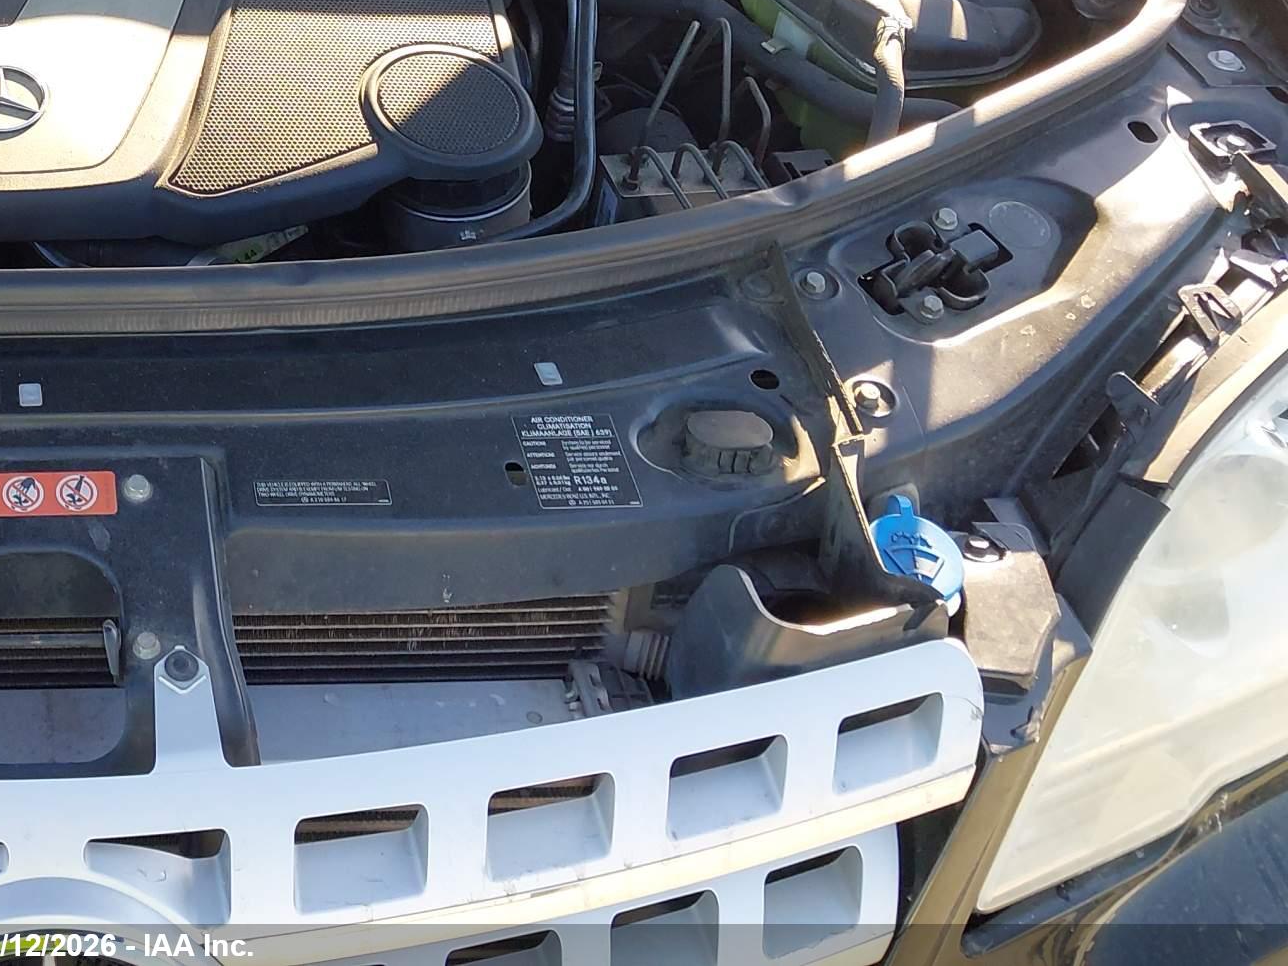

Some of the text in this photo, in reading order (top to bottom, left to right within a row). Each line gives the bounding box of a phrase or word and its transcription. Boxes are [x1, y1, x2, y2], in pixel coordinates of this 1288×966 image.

[544, 415, 593, 423] CONDITIONER
[537, 423, 592, 431] CLIMATISATION
[573, 475, 608, 485] R134a
